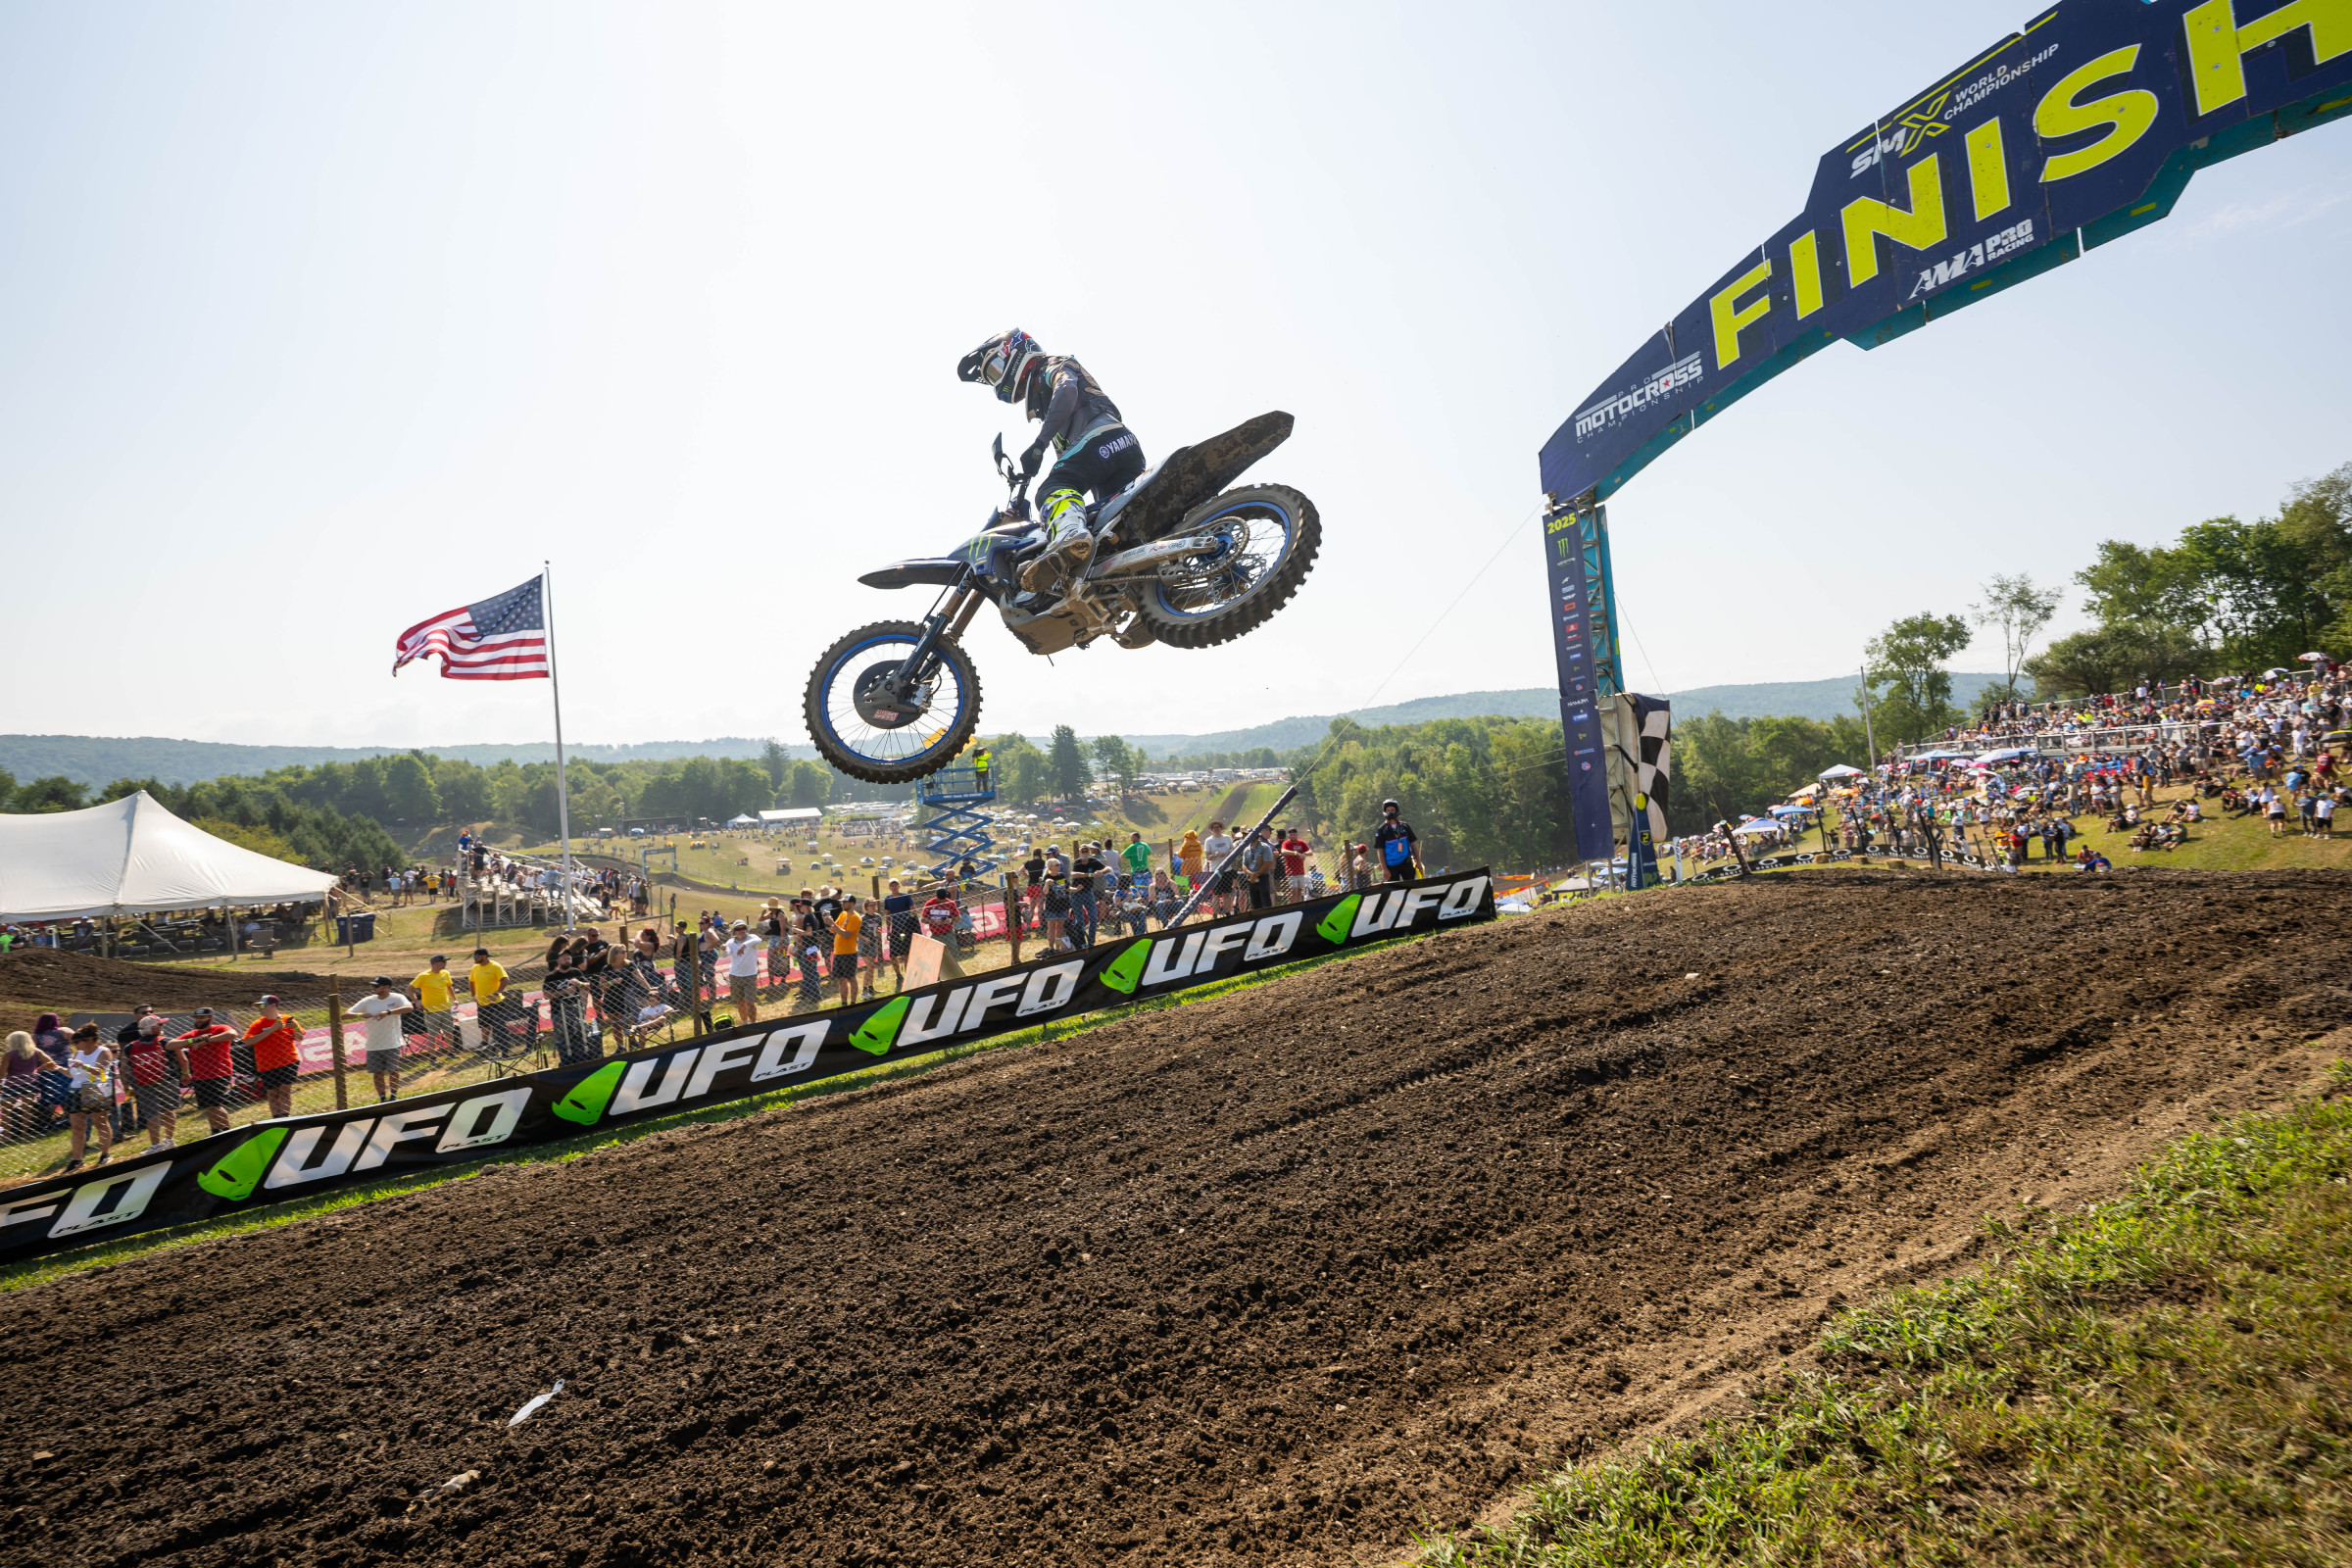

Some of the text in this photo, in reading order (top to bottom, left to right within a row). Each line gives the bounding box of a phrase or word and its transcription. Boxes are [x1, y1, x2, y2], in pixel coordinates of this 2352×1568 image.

[1944, 43, 2059, 121] CHAMPIONSHIP
[1955, 65, 2007, 103] WORLD
[1849, 90, 1951, 179] SMX
[1709, 0, 2352, 370] FINISH
[1985, 219, 2034, 254] PRO
[1987, 233, 2034, 262] RACING
[1906, 243, 1985, 300] AMA
[1575, 358, 1703, 437] MOTOCROSS
[1577, 376, 1703, 443] CHAMPIONSHIP
[1617, 376, 1650, 398] PRO
[1547, 512, 1577, 535] 2025
[1350, 875, 1489, 938] UFO
[1441, 908, 1474, 917] PLAST
[1142, 910, 1303, 986] UFO
[1247, 946, 1289, 958] PLAST
[896, 959, 1085, 1047] UFO
[1019, 999, 1067, 1014] PLAST
[609, 1019, 832, 1115] UFO
[755, 1061, 810, 1079] PLAST
[264, 1087, 533, 1189] UFO
[441, 1133, 509, 1151] PLAST
[54, 1209, 140, 1235] PLAST
